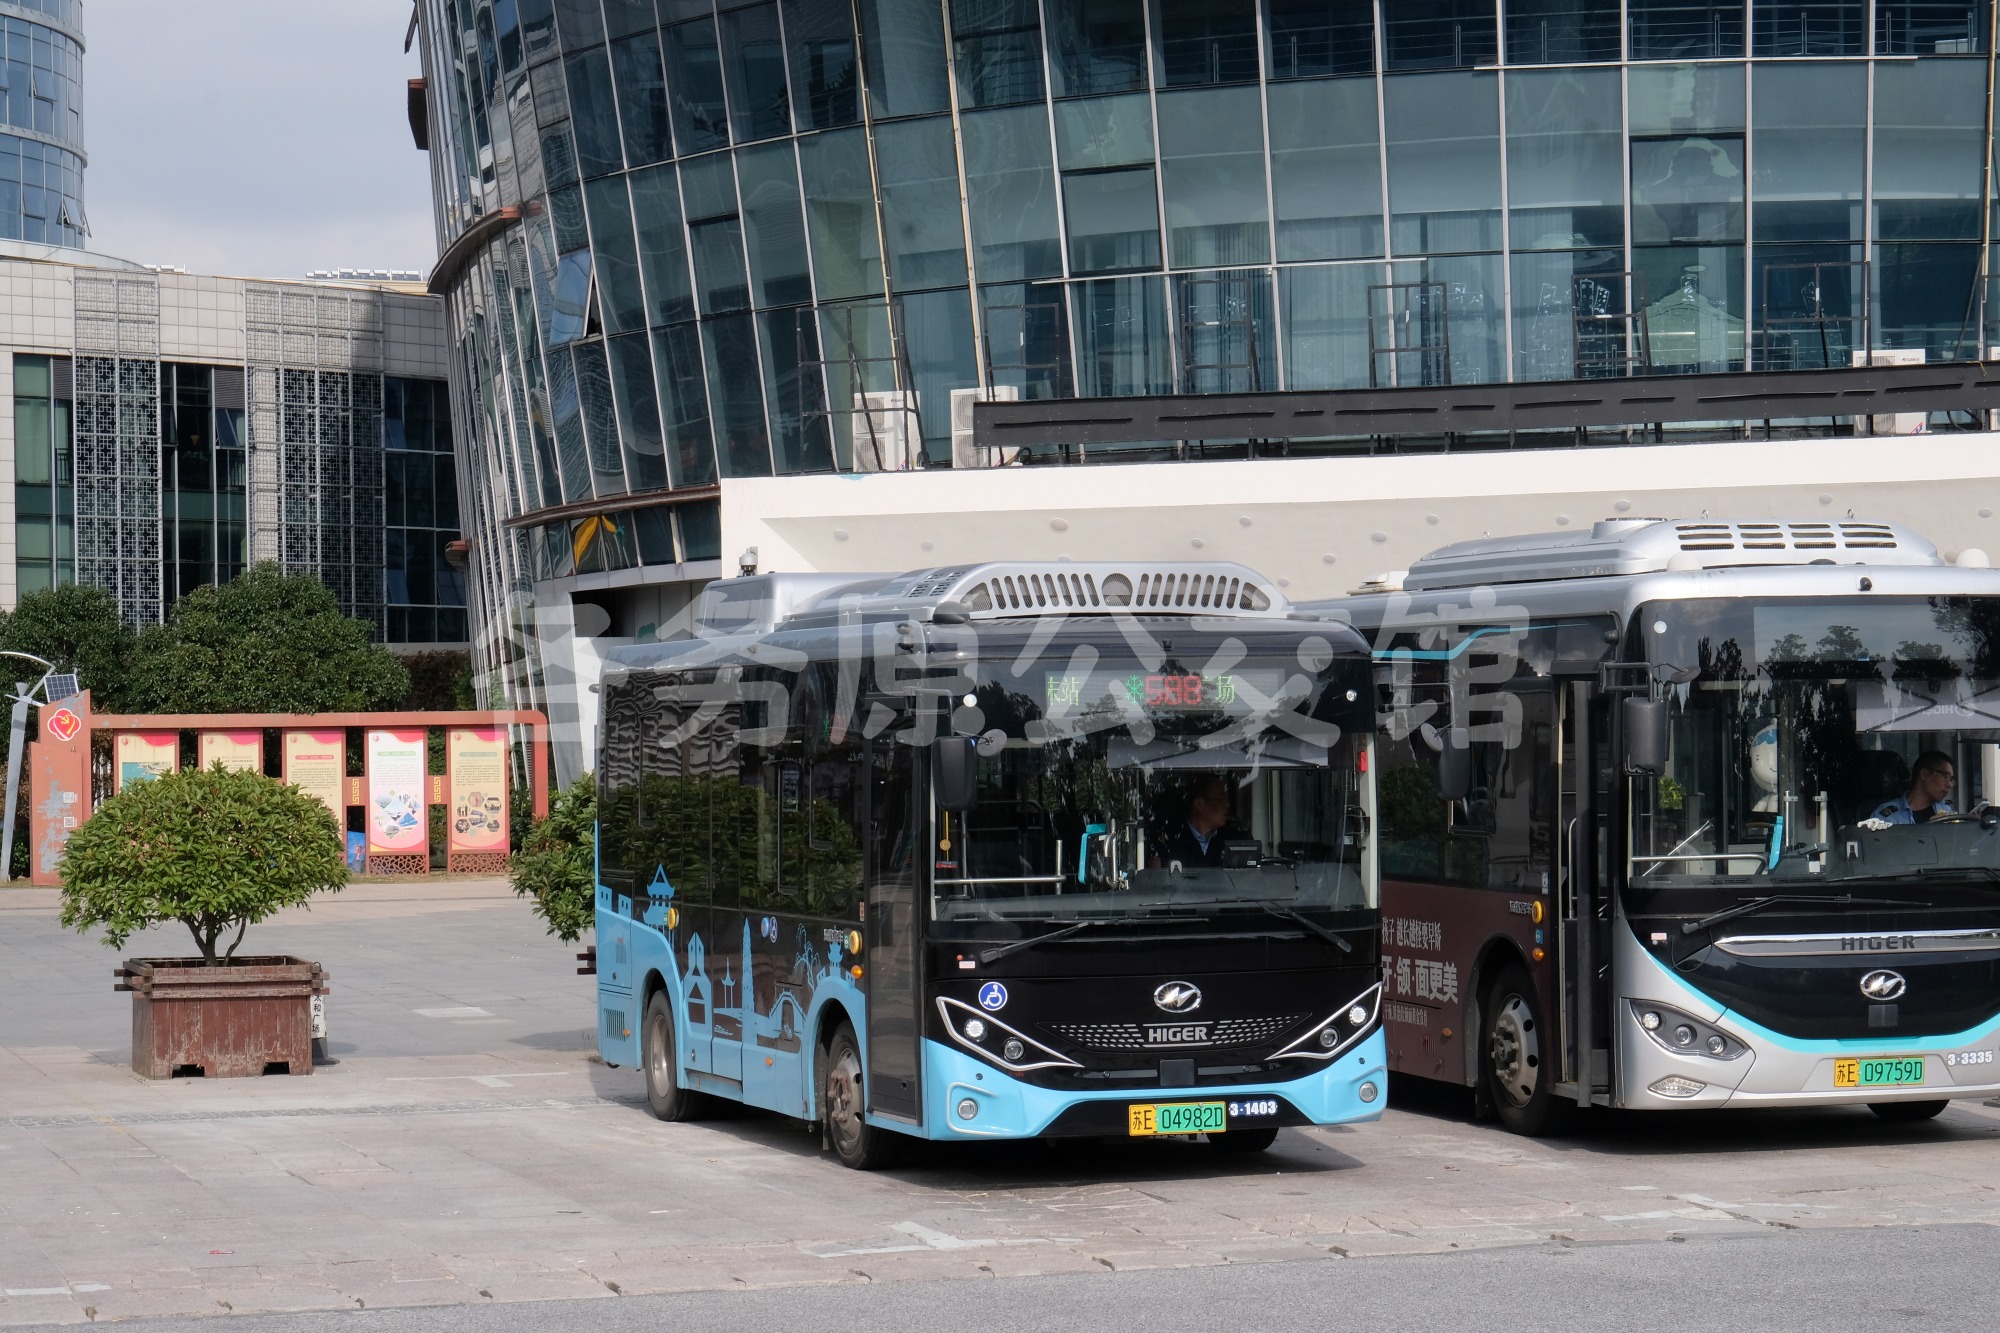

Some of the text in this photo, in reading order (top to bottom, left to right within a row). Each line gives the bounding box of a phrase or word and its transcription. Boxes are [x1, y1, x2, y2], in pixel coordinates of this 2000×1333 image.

[1144, 676, 1201, 705] 588
[1841, 935, 1916, 951] HIGER
[1148, 1026, 1208, 1042] HIGER
